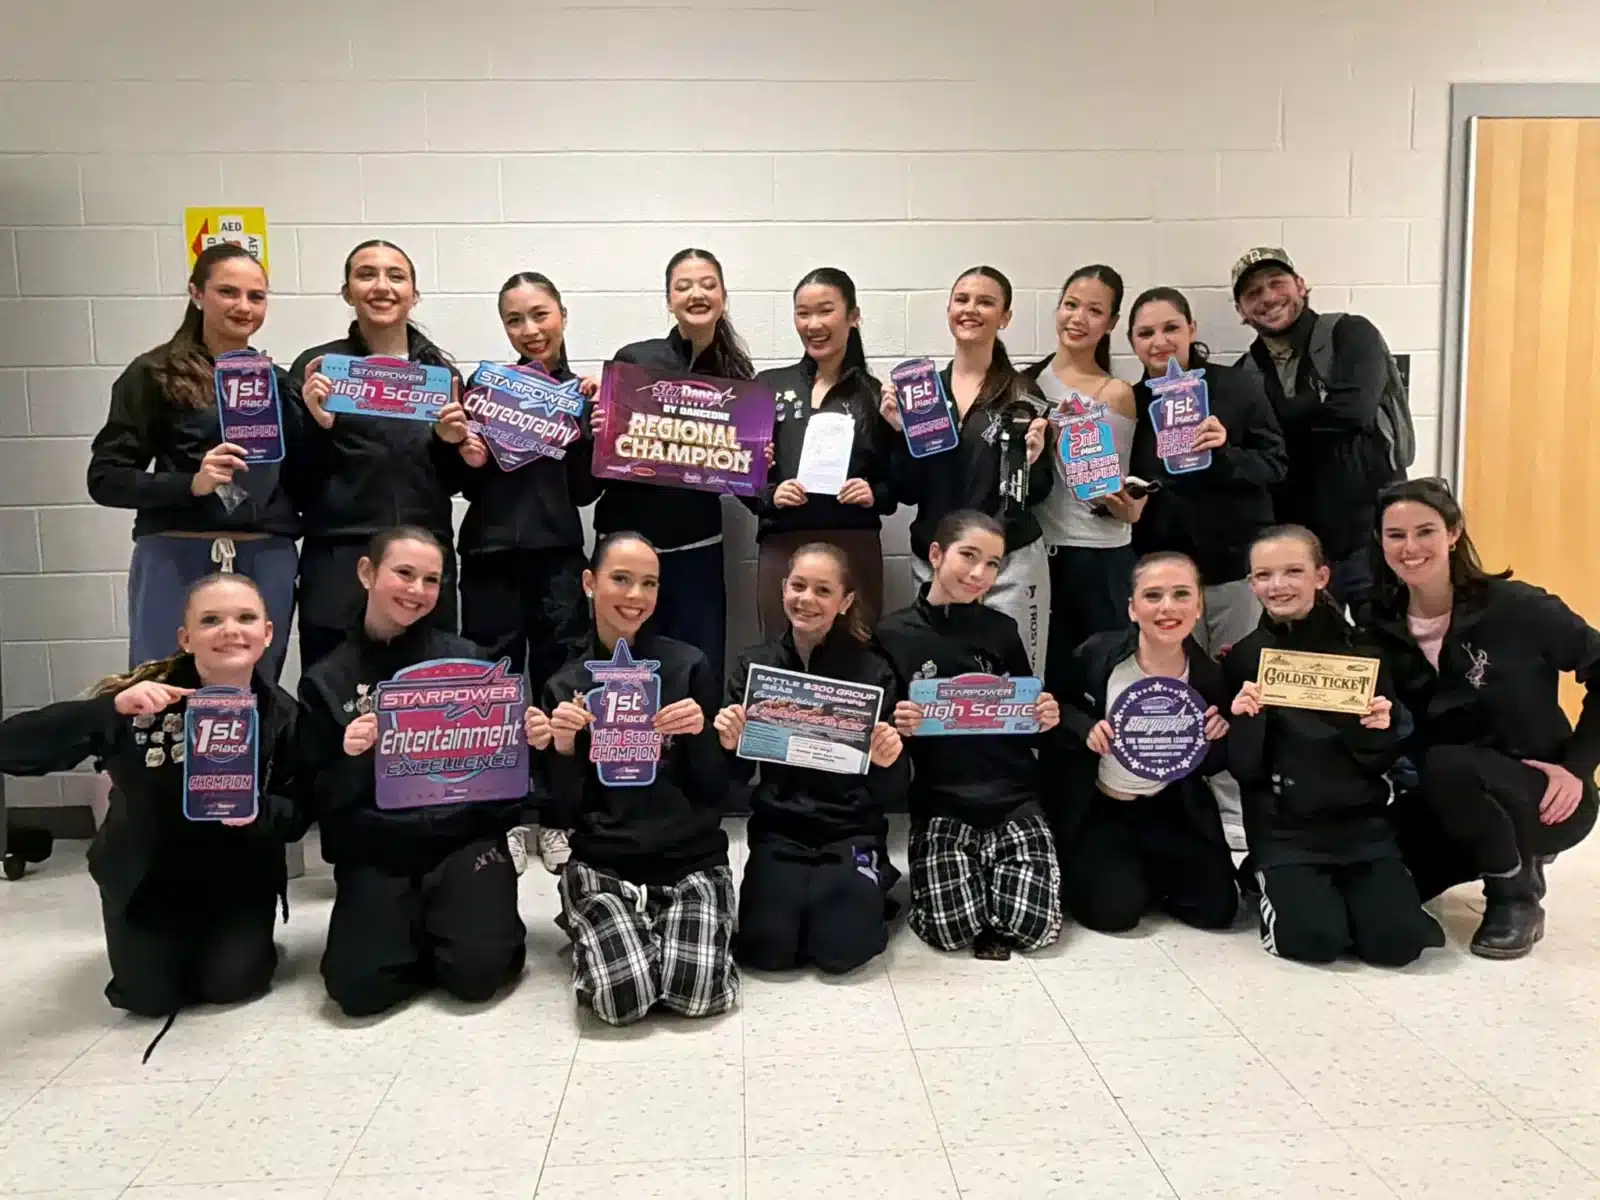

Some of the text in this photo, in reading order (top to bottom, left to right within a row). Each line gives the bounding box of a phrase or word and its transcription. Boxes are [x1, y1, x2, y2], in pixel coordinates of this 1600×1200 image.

[220, 222, 242, 232] AED
[351, 367, 424, 382] STARPOWER
[227, 378, 264, 408] 1st
[381, 385, 447, 405] Score
[480, 371, 579, 411] STARPOWER
[902, 380, 932, 411] 1st
[463, 394, 578, 447] Choreography
[662, 404, 731, 421] BY DANCEZONE
[1164, 396, 1193, 426] 1st
[226, 425, 279, 439] CHAMPION
[468, 420, 567, 460] EXCELLENCE
[627, 411, 742, 450] REGIONAL
[1069, 427, 1100, 459] 2nd
[614, 433, 754, 475] CHAMPION
[756, 673, 877, 701] BATTLE $300 GROUP
[939, 688, 1012, 697] STARPOWER
[1264, 667, 1319, 686] GOLDEN
[1321, 676, 1370, 695] TICKET
[383, 686, 518, 707] STARPOWER
[606, 691, 643, 724] 1st
[813, 692, 866, 707] Scholarship
[969, 703, 1034, 717] Score
[197, 718, 244, 754] 1st
[209, 743, 248, 753] Place
[380, 718, 522, 755] Entertainment
[591, 728, 662, 747] High Score
[386, 752, 519, 777] EXCELLENCE
[590, 744, 661, 763] CHAMPION
[188, 774, 253, 791] CHAMPION
